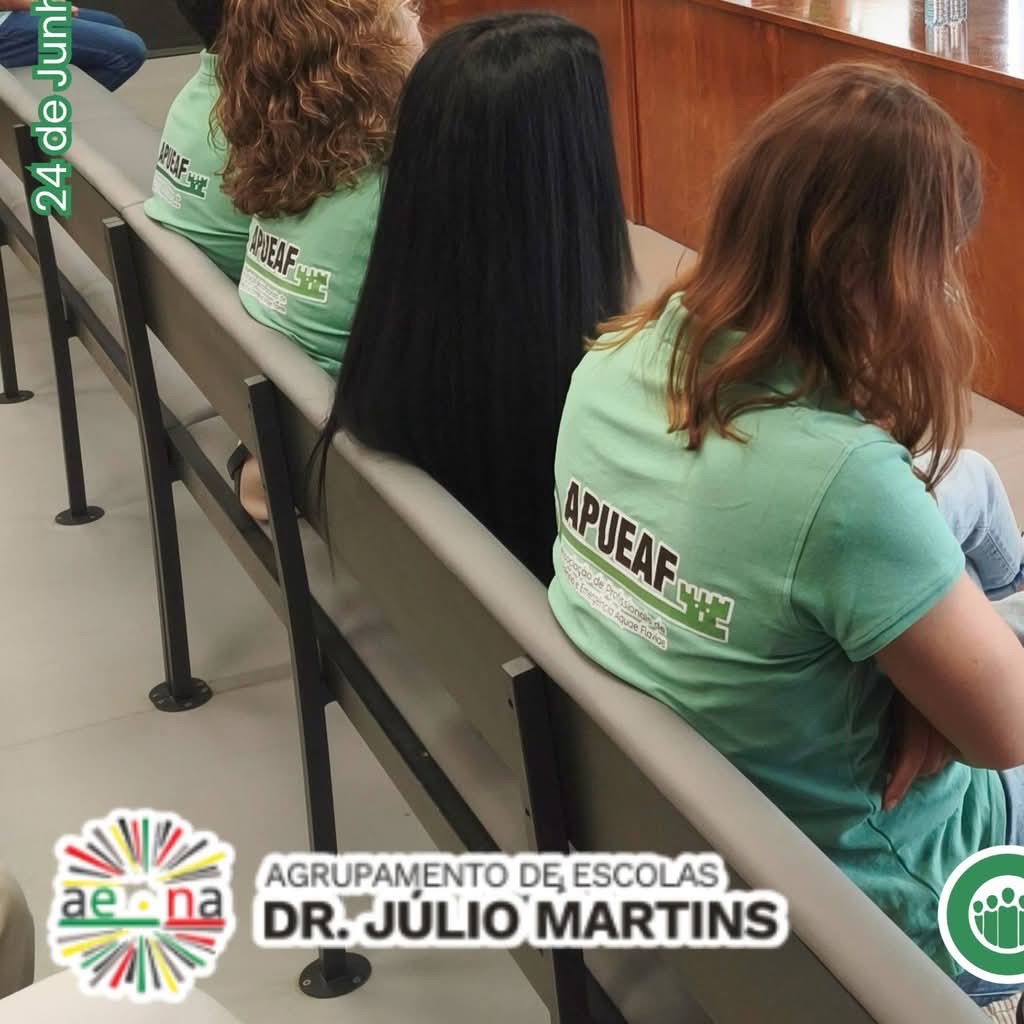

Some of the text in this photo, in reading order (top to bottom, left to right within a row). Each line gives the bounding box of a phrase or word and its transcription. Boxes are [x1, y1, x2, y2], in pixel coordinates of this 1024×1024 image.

[158, 142, 190, 179] APUEAF
[250, 225, 299, 275] APUEAF
[564, 480, 678, 592] APUEAF
